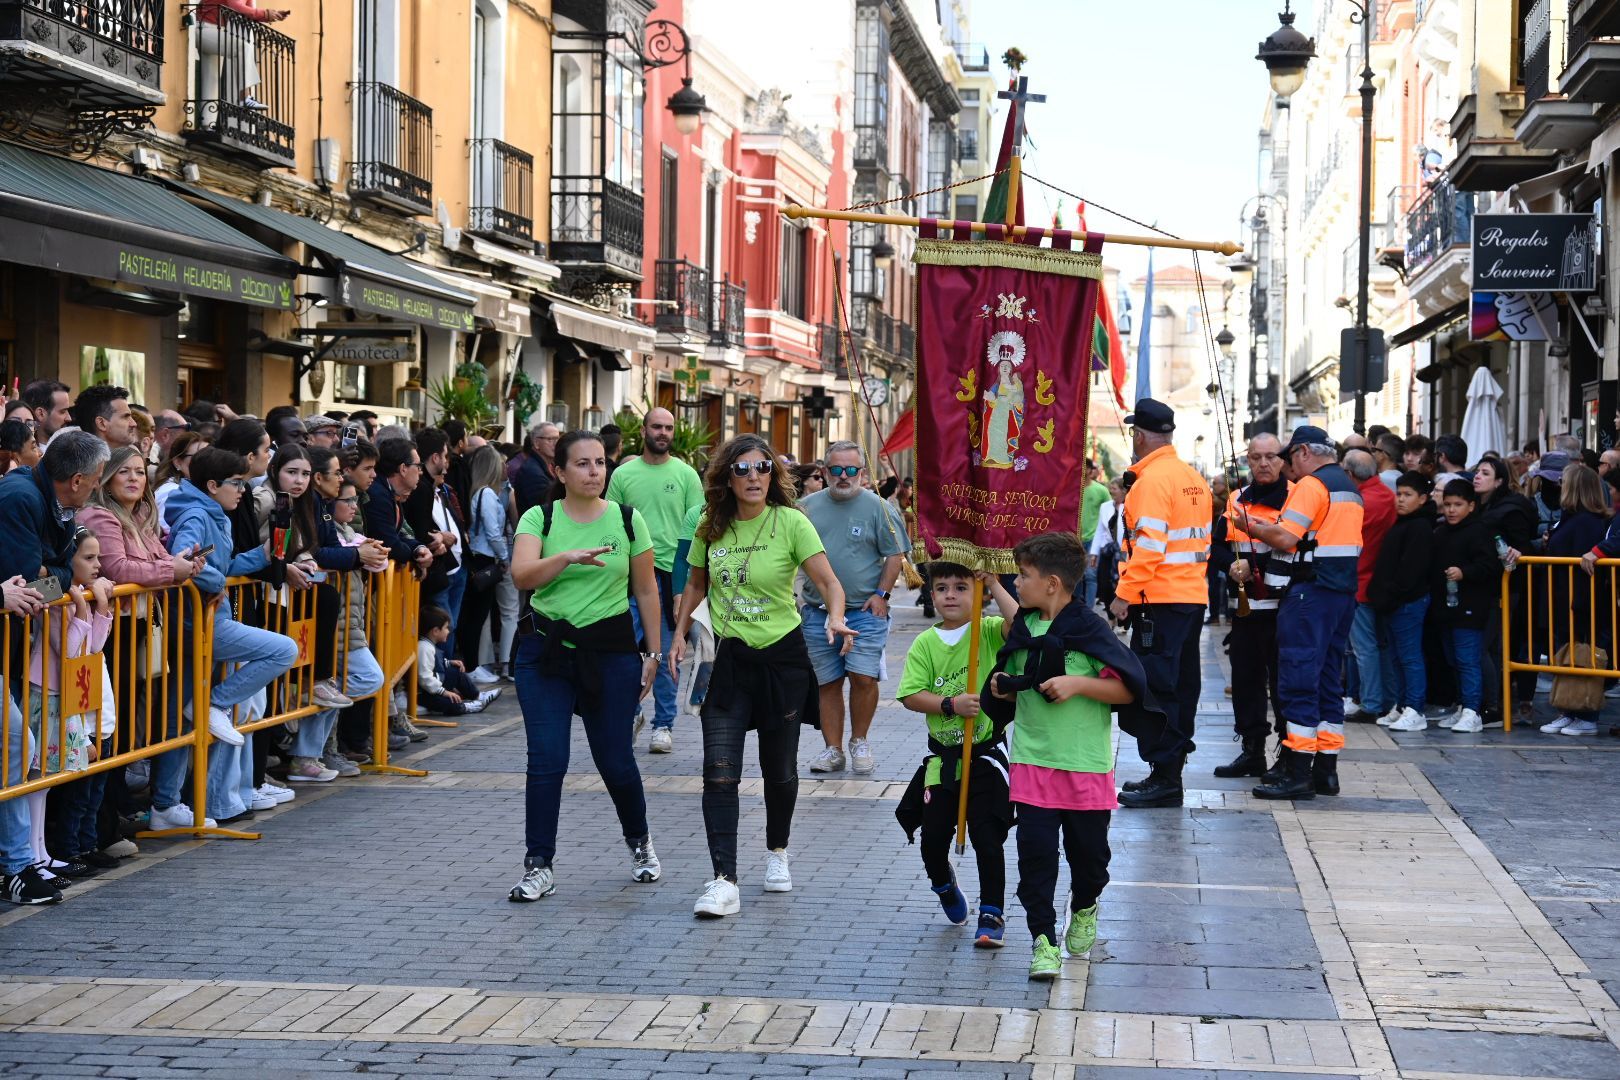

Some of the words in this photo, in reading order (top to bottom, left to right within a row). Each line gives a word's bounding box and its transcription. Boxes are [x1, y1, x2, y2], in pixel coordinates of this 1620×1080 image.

[1479, 227, 1548, 254] Regalos
[119, 252, 177, 282] PASTELERÍA
[183, 265, 232, 292] HELADERÍA
[1480, 258, 1556, 278] Souvenir
[363, 287, 400, 311] PASTELERÍA
[403, 299, 434, 319] HELADERÍA
[331, 342, 400, 360] vinoteca
[941, 483, 998, 507] NUETRA
[1003, 490, 1057, 511] SEÑORA
[992, 514, 1018, 528] DEL
